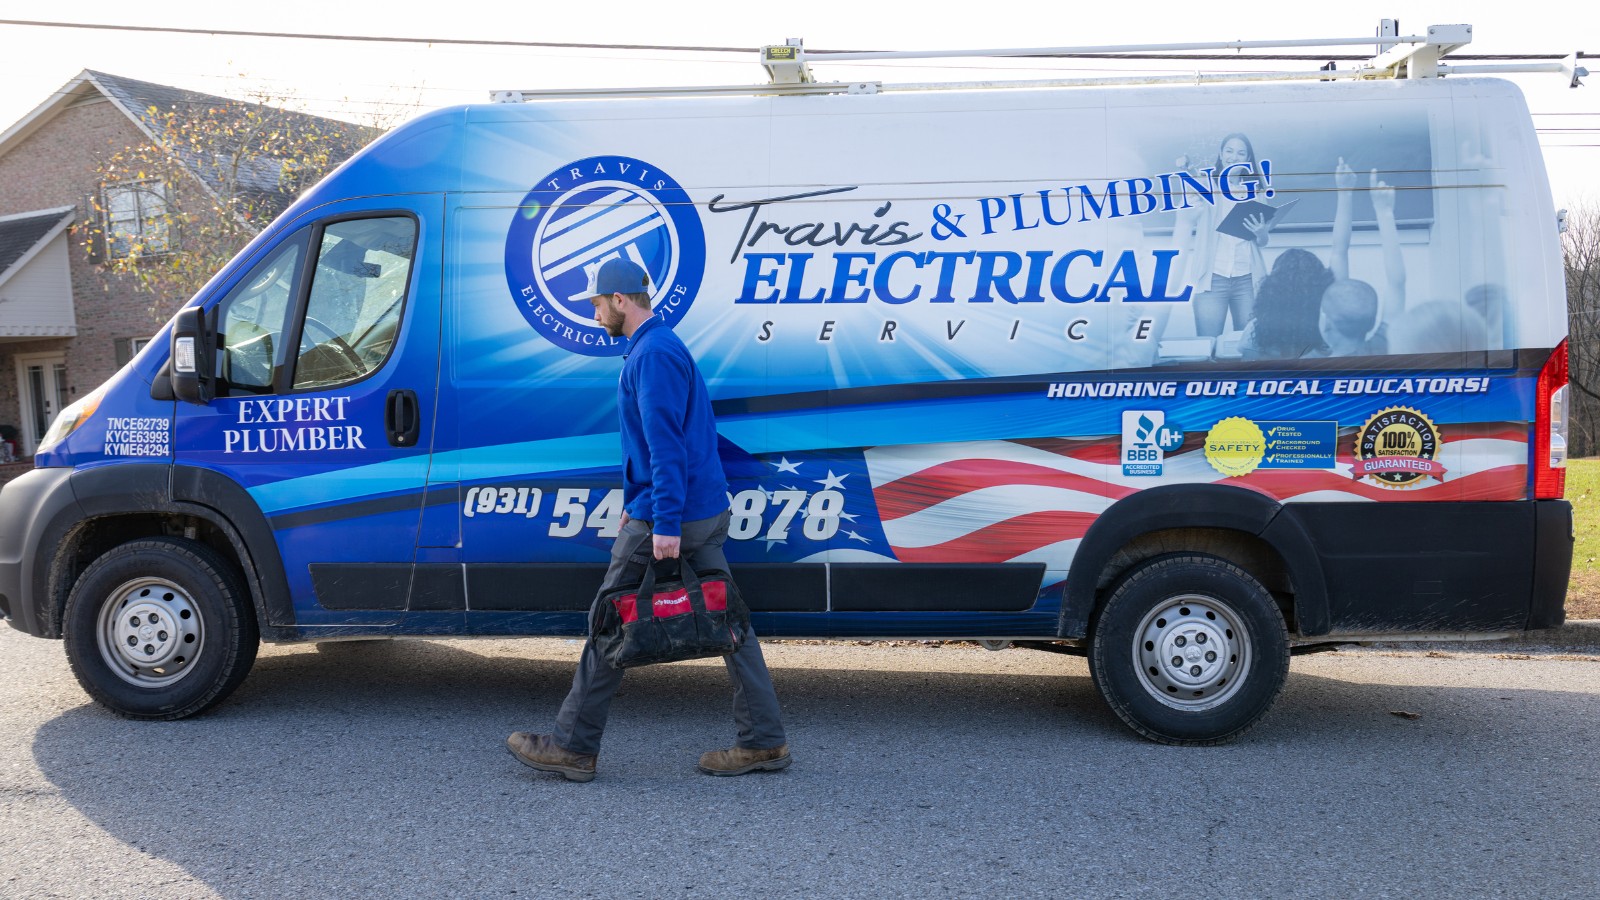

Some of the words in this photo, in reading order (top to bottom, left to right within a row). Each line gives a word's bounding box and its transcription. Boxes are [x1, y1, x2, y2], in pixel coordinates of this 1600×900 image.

[548, 162, 666, 192] TRAVIS
[708, 185, 924, 264] Travis
[931, 203, 967, 241] &
[976, 160, 1276, 236] PLUMBING!
[734, 249, 1193, 304] ELECTRICAL
[521, 284, 619, 346] ELECTRICAL
[758, 319, 1151, 341] SERVICE
[1047, 382, 1177, 398] HONORING
[1185, 381, 1238, 396] OUR
[1246, 379, 1322, 395] LOCAL
[1332, 377, 1490, 394] EDUCATORS!
[237, 395, 351, 424] EXPERT
[107, 417, 169, 431] TNCE62739
[1364, 414, 1433, 450] SATISFACTION
[105, 430, 169, 444] KYCE63993
[223, 425, 366, 454] PLUMBER
[1159, 428, 1182, 447] A+
[1382, 431, 1416, 449] 100%
[104, 443, 170, 456] KYME64294
[1127, 449, 1158, 461] BBB
[1364, 459, 1432, 471] GUARANTEED
[463, 487, 542, 518] (931)
